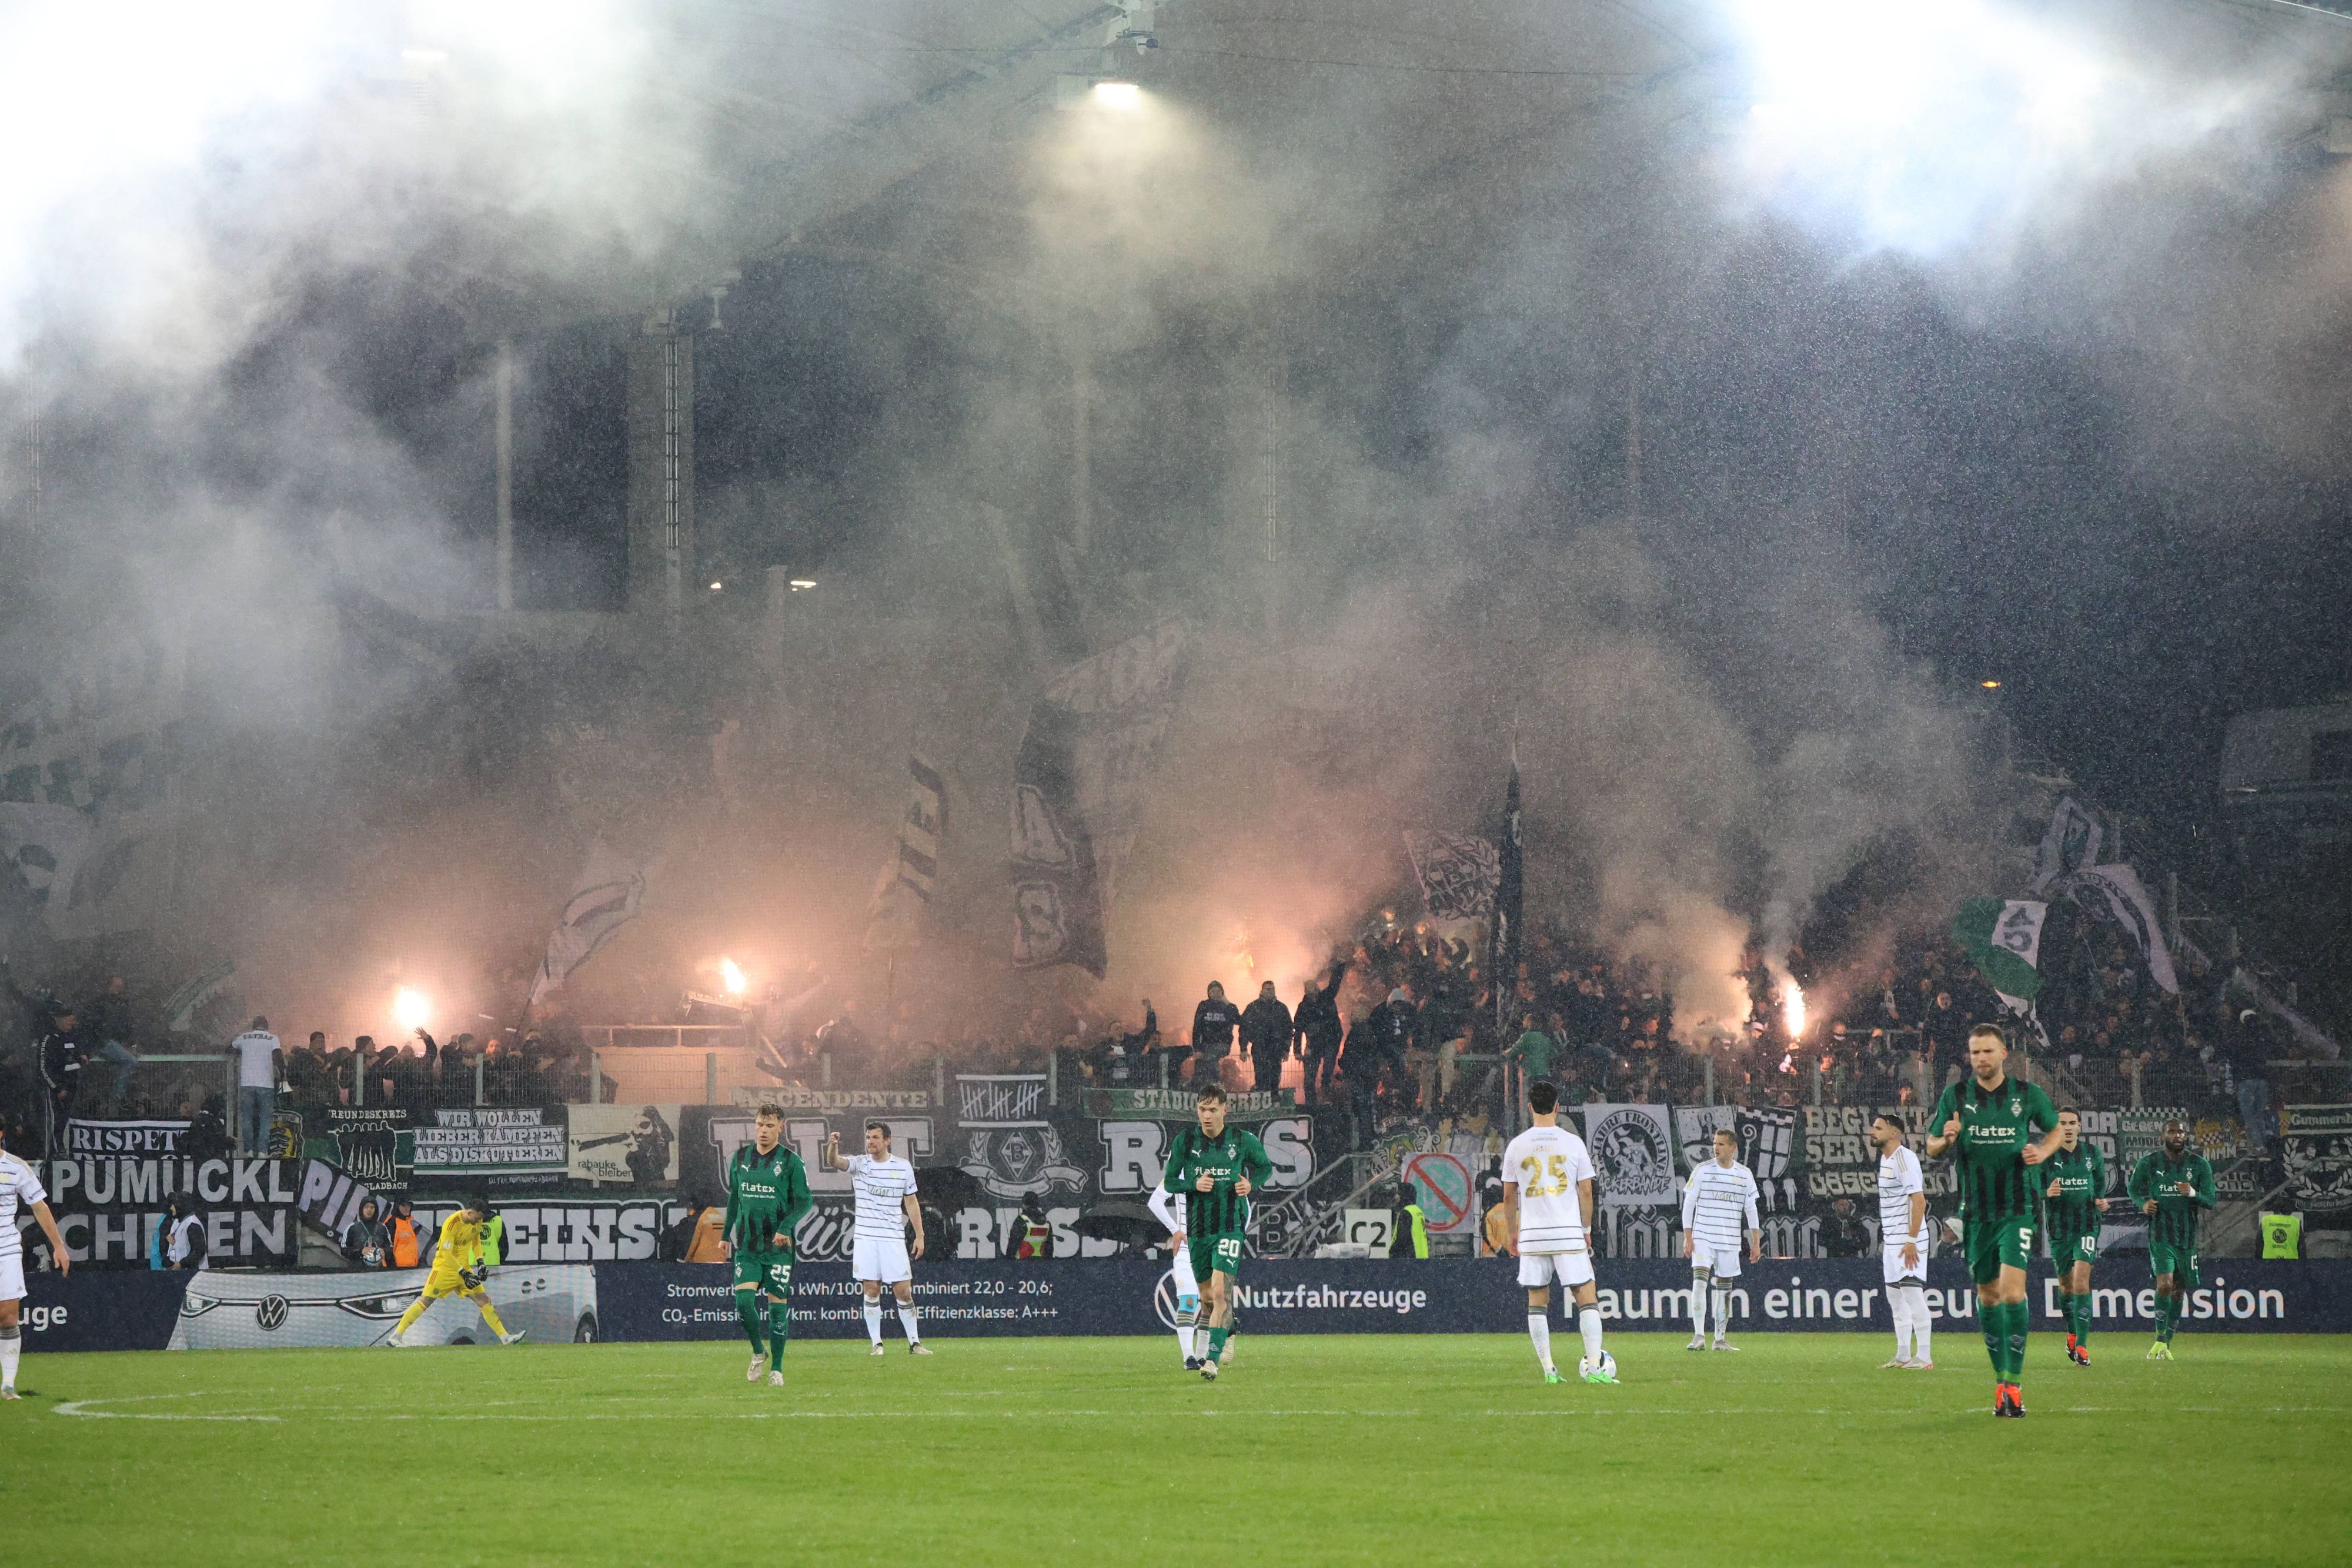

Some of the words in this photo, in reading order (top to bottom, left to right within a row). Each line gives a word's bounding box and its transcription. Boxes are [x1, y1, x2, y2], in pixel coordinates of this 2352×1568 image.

[329, 1109, 407, 1119] REUNDESKREIS
[436, 1110, 472, 1128] WIR
[474, 1109, 542, 1127] WOLLEN
[413, 1128, 480, 1145] LIEBER
[1967, 1125, 2016, 1136] flatex
[414, 1147, 448, 1164] ALS
[450, 1145, 564, 1163] DISKUTIEREN
[578, 1159, 616, 1171] rabauke
[1194, 1166, 1231, 1176] flatex
[1521, 1155, 1568, 1198] 25
[741, 1182, 776, 1193] flatex
[2159, 1183, 2179, 1192] flat
[1351, 1221, 1386, 1248] C2
[2019, 1227, 2032, 1249] 5
[1218, 1238, 1240, 1258] 20
[2081, 1236, 2095, 1252] 10
[770, 1264, 791, 1283] 25
[799, 1282, 863, 1296] kWh/100
[974, 1281, 1004, 1296] 22,0
[1018, 1280, 1053, 1296] 20,6;
[1233, 1285, 1427, 1314] Nutzfahrzeuge
[1764, 1276, 1878, 1319] einer
[18, 1303, 68, 1330] uge
[916, 1305, 1018, 1320] Effizienzklasse:
[1021, 1305, 1058, 1320] A+++
